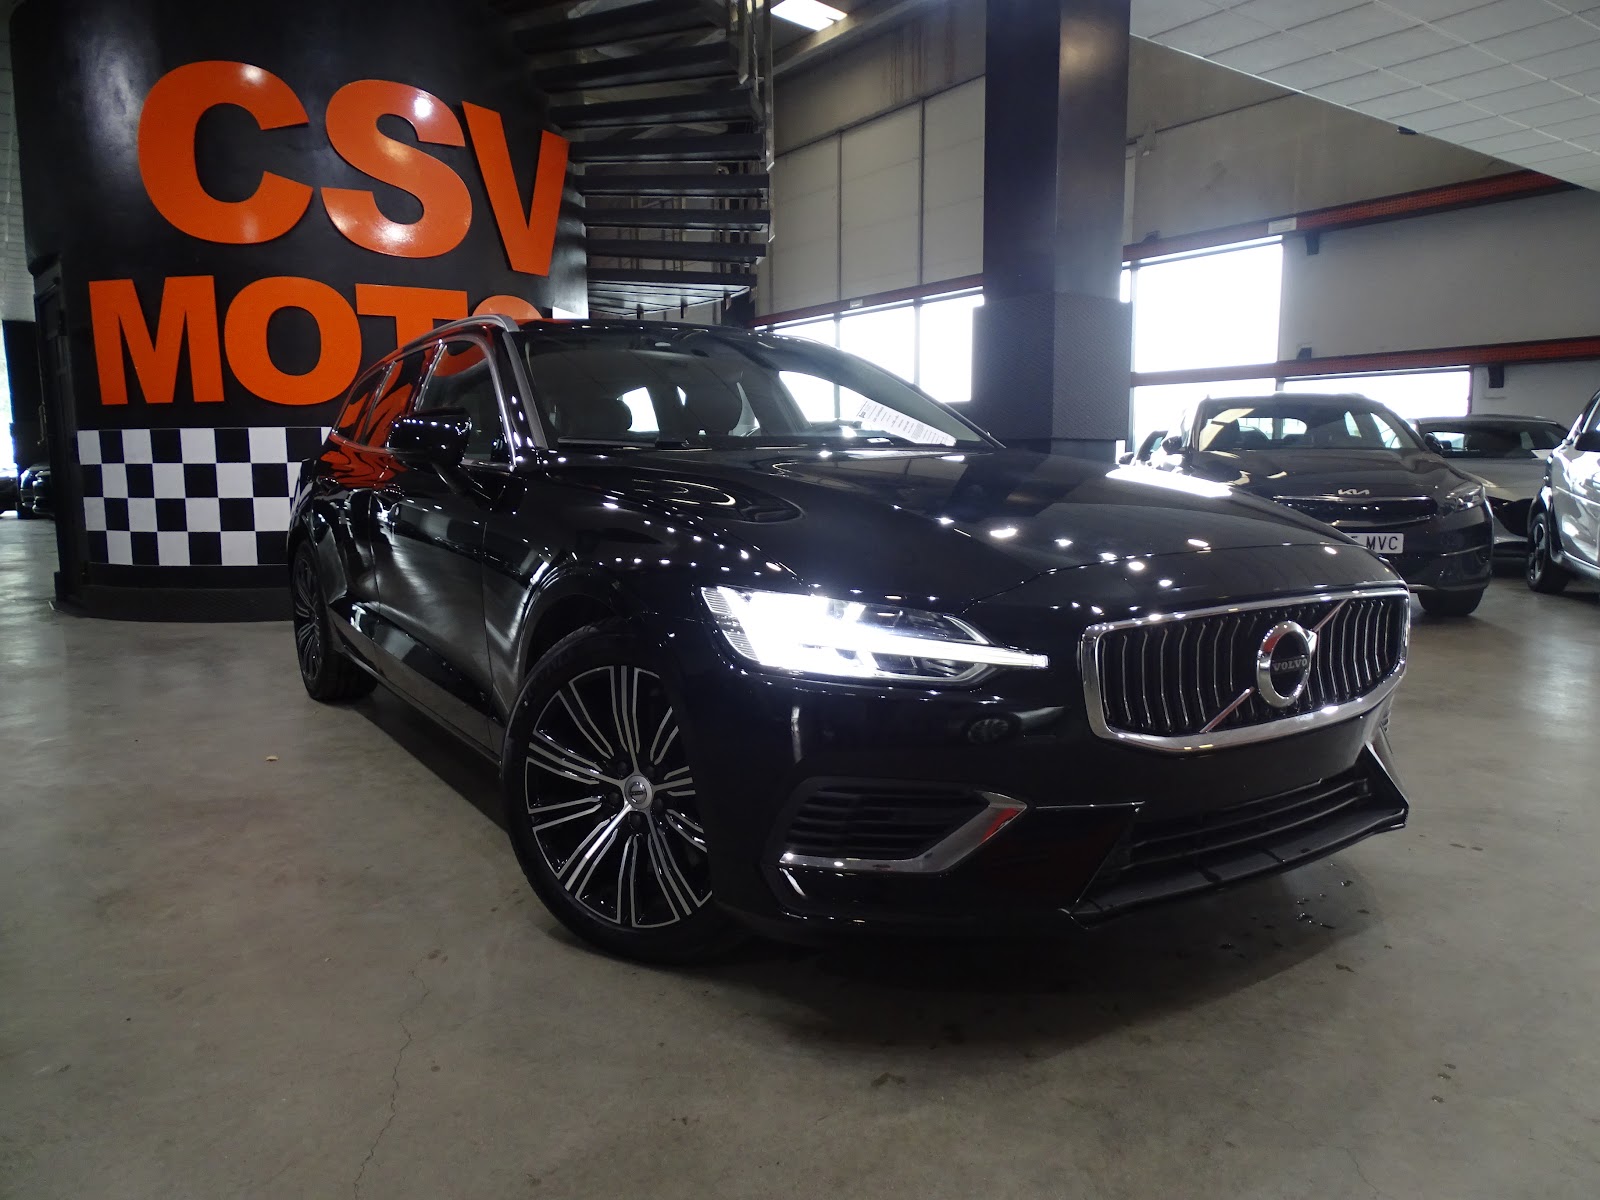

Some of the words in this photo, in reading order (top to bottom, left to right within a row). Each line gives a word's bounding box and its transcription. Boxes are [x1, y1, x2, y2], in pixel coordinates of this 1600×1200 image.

[138, 60, 569, 277] CSV
[89, 275, 542, 406] MOT
[1366, 535, 1398, 551] MVC
[1273, 659, 1308, 671] VOLVO
